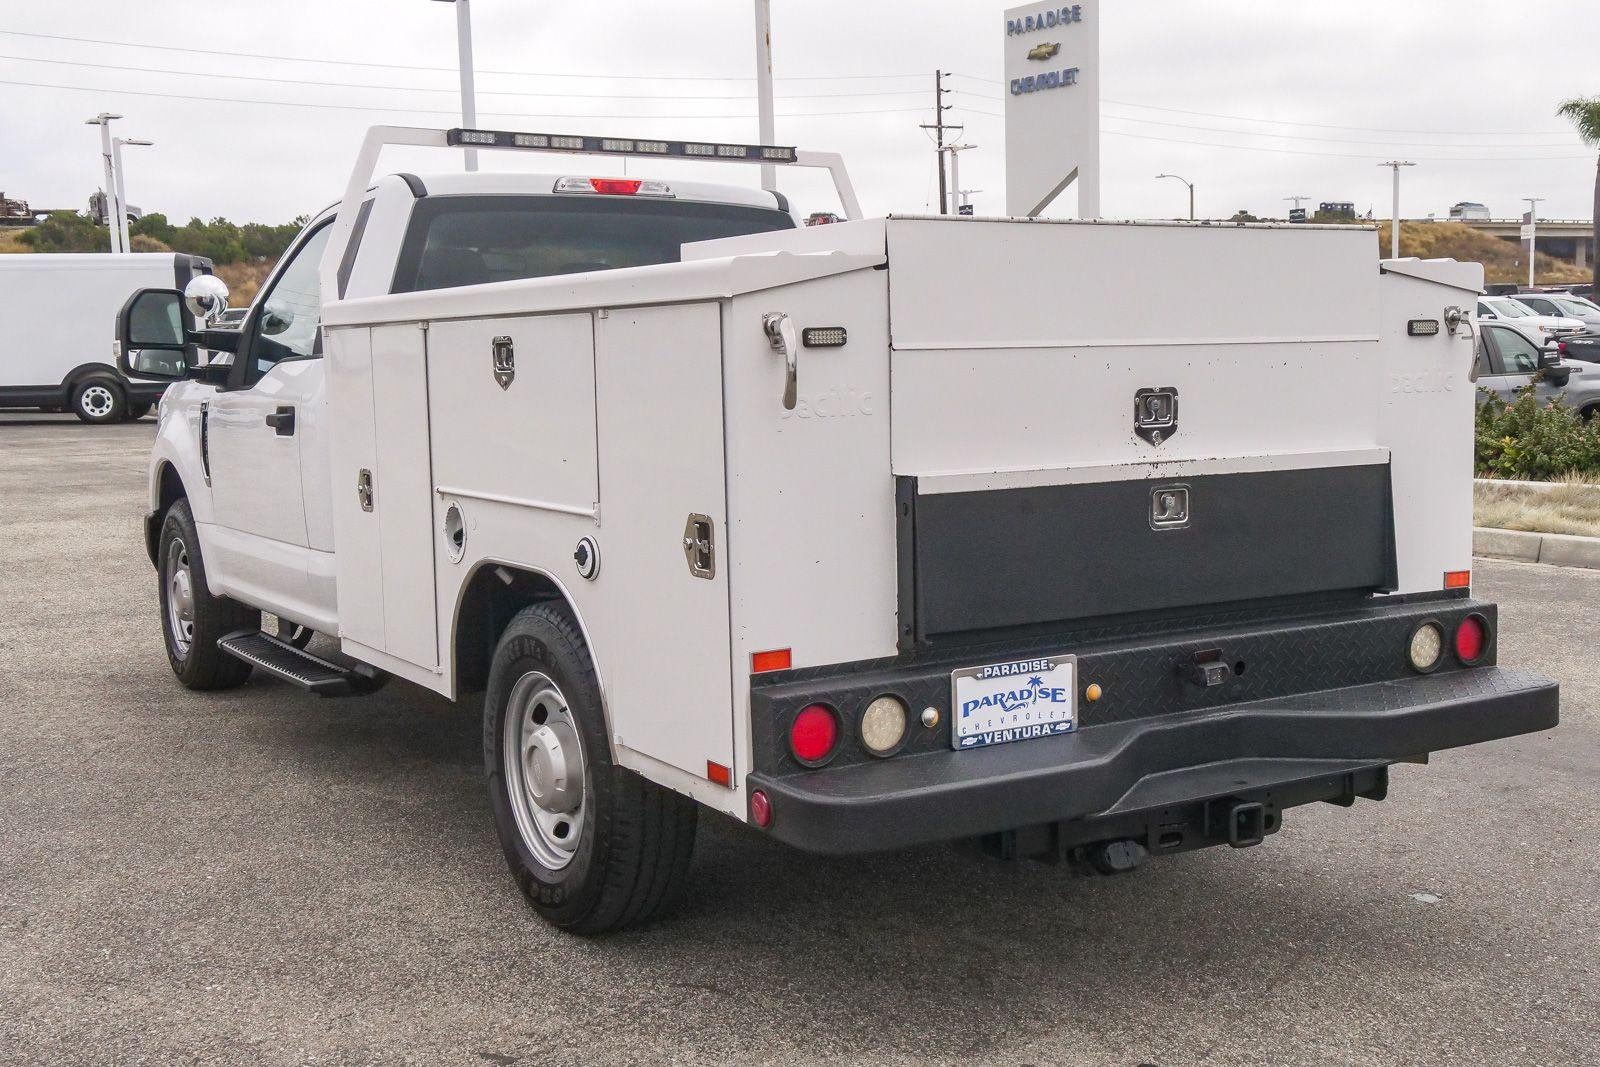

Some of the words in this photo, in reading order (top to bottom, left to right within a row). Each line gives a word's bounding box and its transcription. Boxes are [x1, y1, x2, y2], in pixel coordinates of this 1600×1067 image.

[1007, 4, 1081, 37] PARADISE
[983, 660, 1048, 678] PARADISE
[962, 675, 1067, 718] PARADISE
[962, 711, 1066, 735] CHEVROLET
[983, 723, 1052, 744] VENTURA
